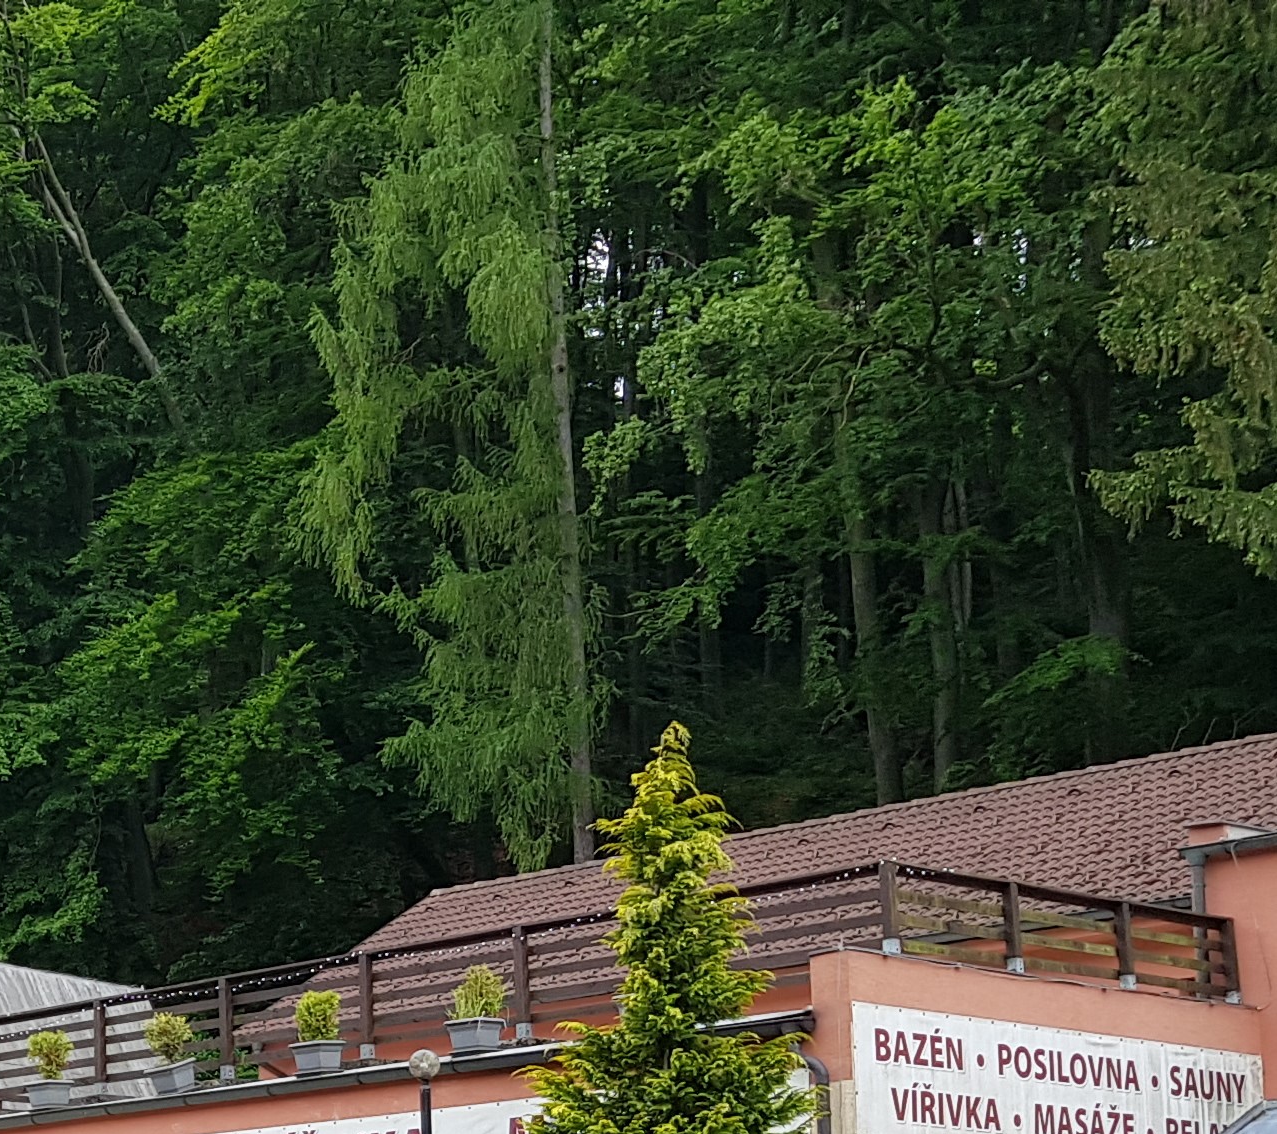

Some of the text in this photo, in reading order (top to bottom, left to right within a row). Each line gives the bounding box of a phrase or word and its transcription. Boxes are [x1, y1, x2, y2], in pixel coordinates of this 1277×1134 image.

[874, 1028, 1245, 1104] BAZÉN POSILOVNA SAUNY
[890, 1082, 1001, 1131] VÍŘIVKA
